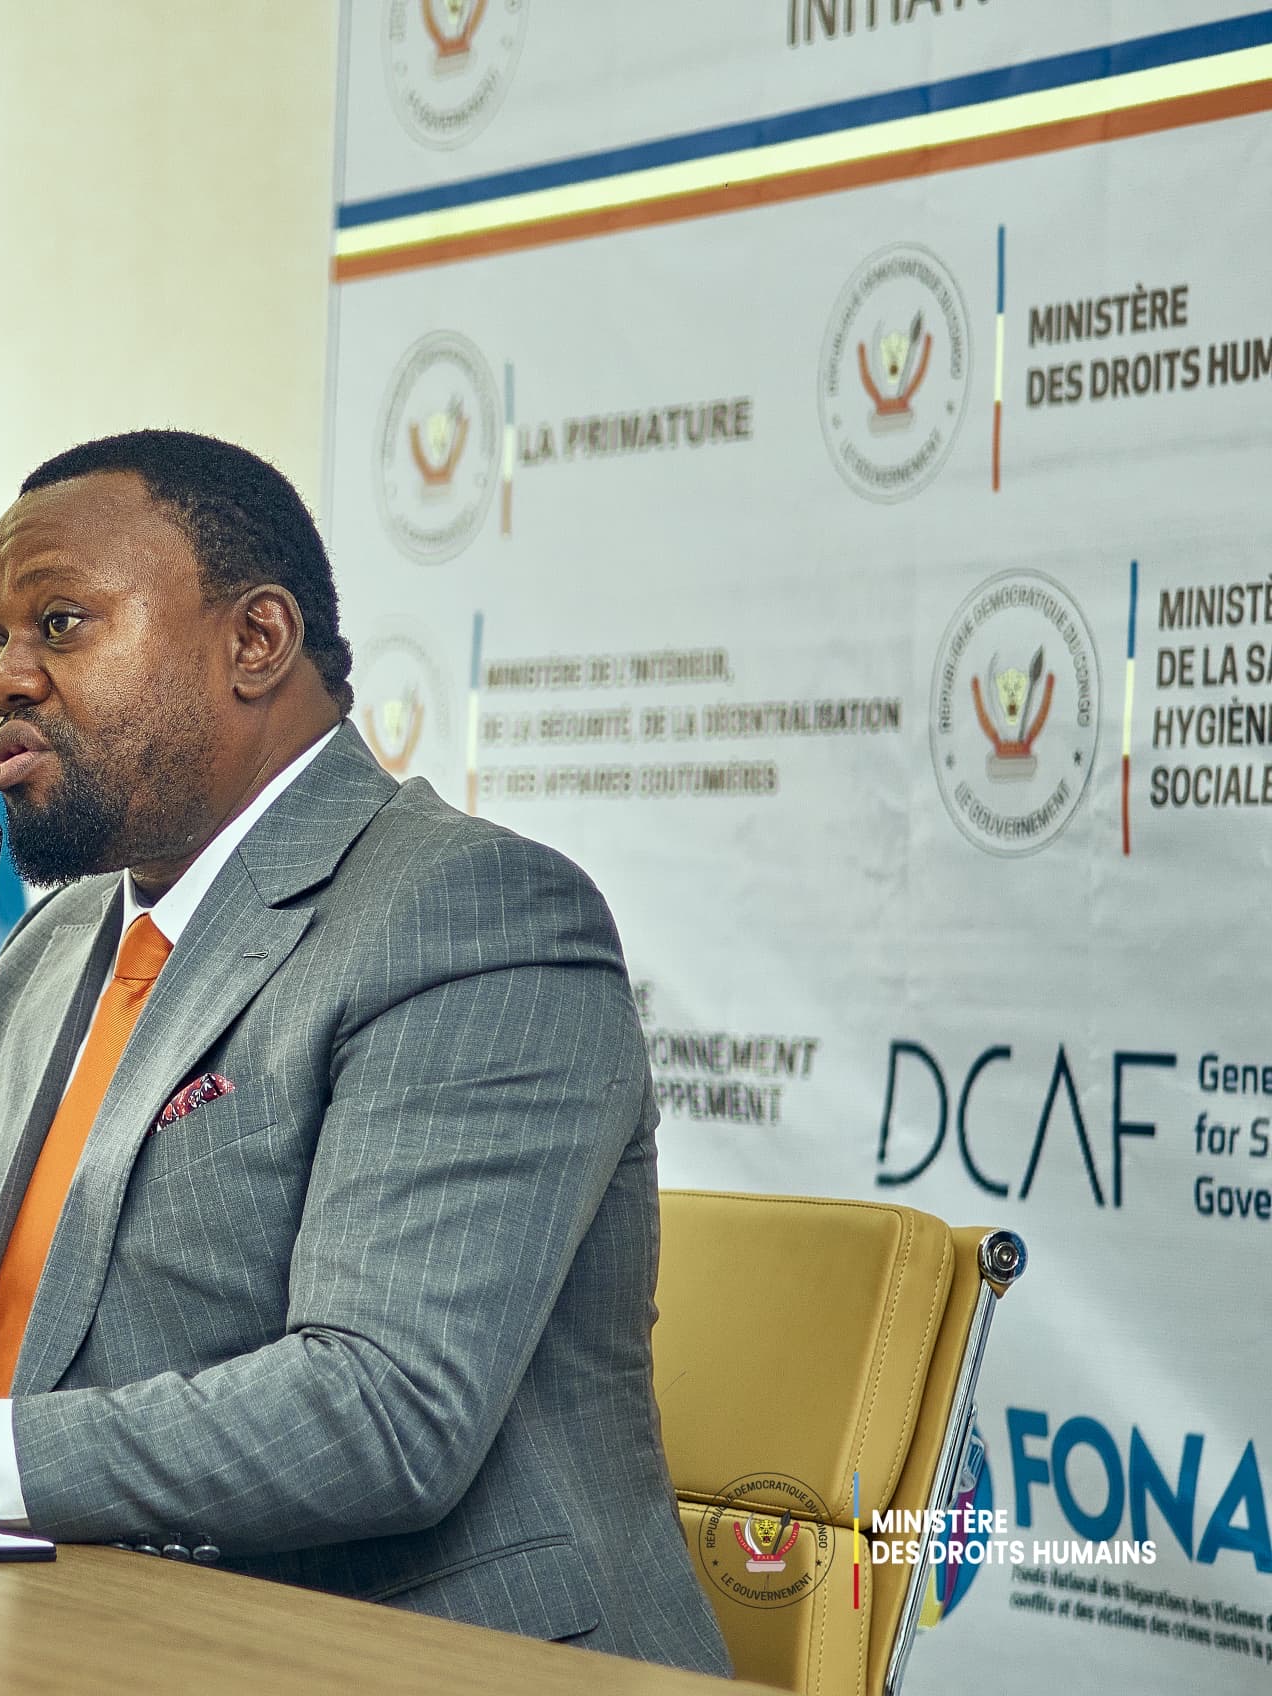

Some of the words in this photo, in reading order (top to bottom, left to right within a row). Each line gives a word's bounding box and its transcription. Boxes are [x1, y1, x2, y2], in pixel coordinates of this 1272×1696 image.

[1030, 282, 1189, 347] MINISTÈRE
[1027, 361, 1083, 408] DES
[1090, 347, 1201, 401] DROITS
[1157, 646, 1196, 690] DE
[1202, 644, 1239, 688] LA
[1152, 697, 1272, 750] HYGIÈN
[875, 1040, 1178, 1208] DCAF
[1195, 1112, 1241, 1155] for
[1194, 1175, 1271, 1220] Gove
